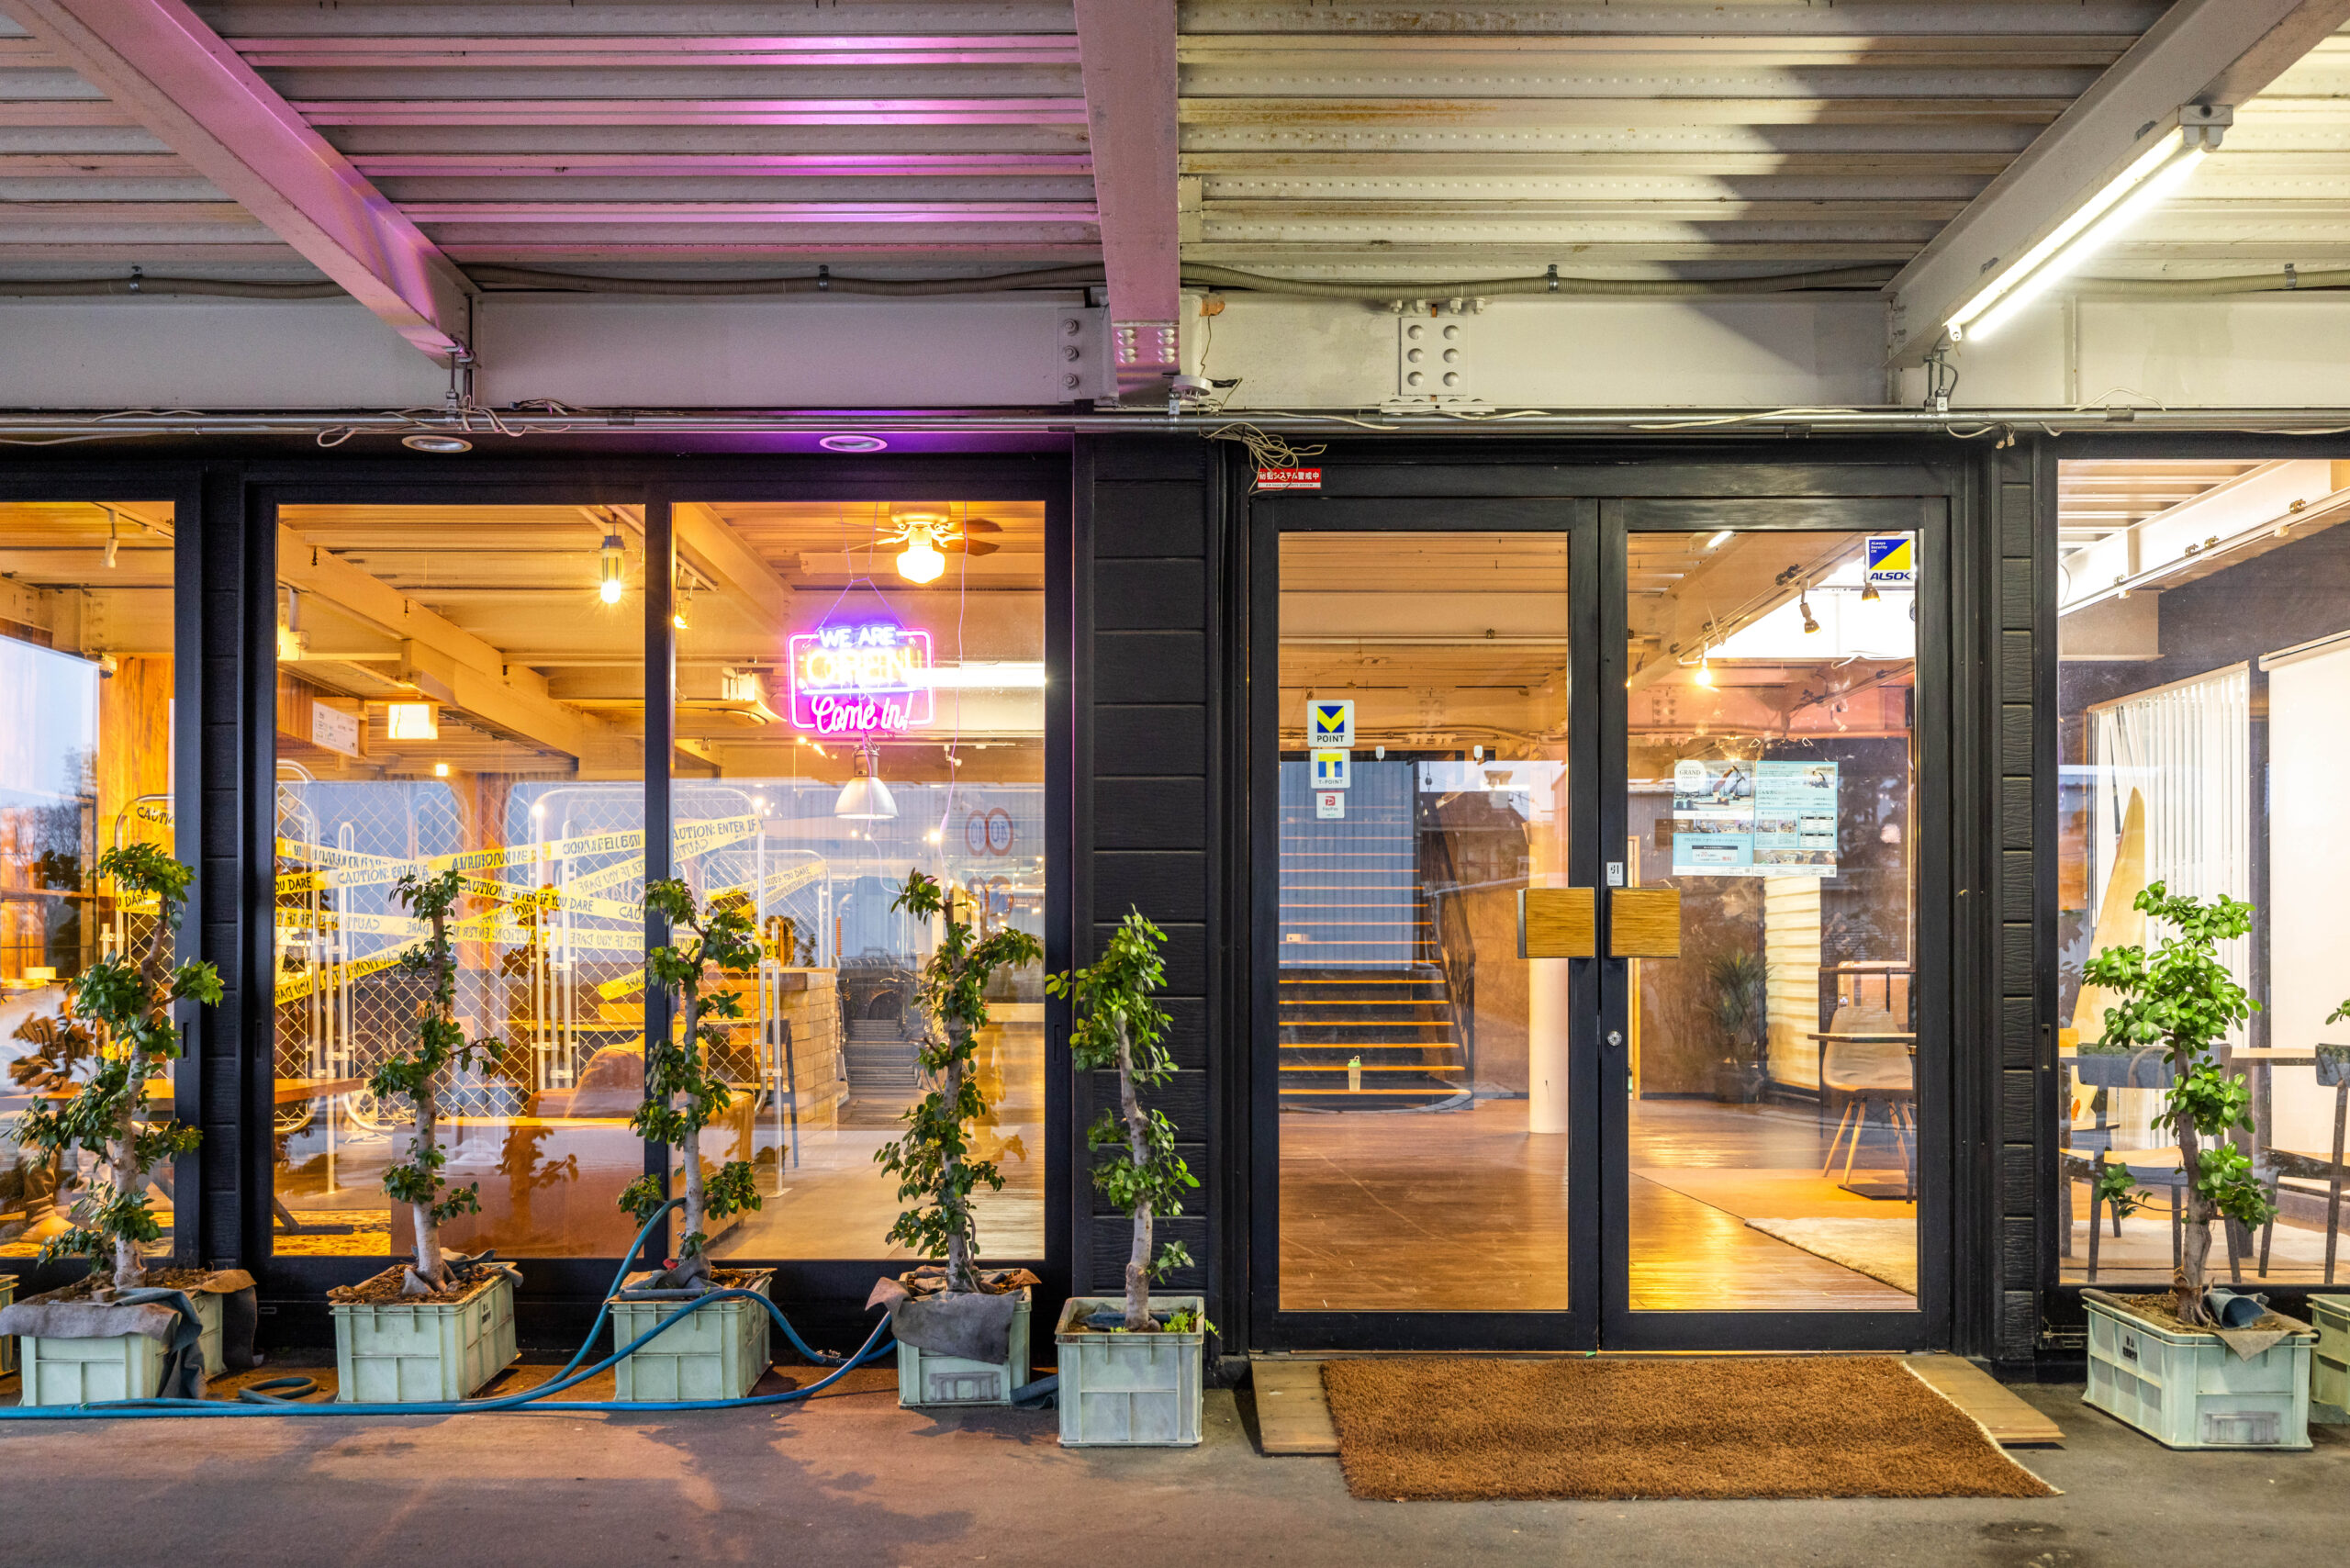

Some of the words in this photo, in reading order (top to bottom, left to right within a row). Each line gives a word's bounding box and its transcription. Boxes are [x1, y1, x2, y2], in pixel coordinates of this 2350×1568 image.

[1870, 572, 1910, 580] ALSOK
[819, 628, 853, 648] WE
[858, 627, 896, 646] ARE
[806, 646, 911, 686] OPEN
[811, 695, 877, 734] Come
[717, 821, 744, 835] ENTER
[747, 818, 756, 832] IF
[287, 876, 312, 890] DARE
[338, 868, 390, 884] CAUTION:
[1610, 865, 1619, 874] 引
[510, 887, 536, 902] ENTER
[539, 893, 550, 905] IF
[552, 894, 567, 908] YOU
[570, 897, 594, 912] DARE
